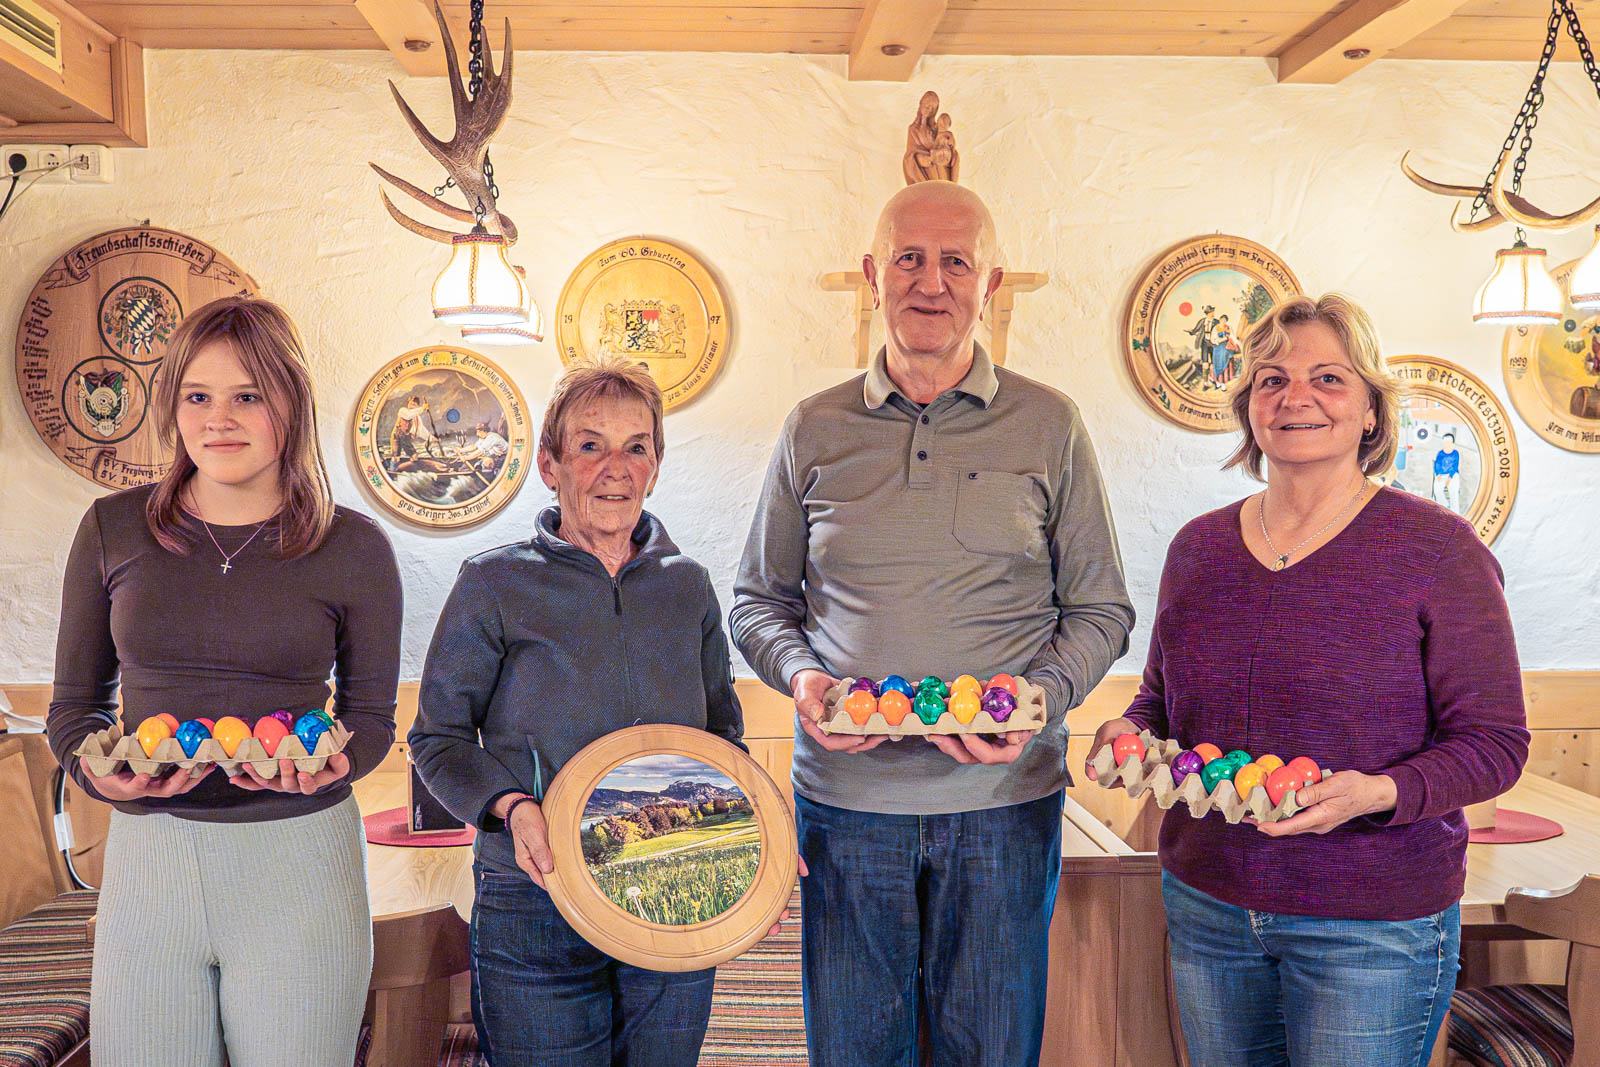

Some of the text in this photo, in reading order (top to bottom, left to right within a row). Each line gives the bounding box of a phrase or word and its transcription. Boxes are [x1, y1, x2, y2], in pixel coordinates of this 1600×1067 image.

[598, 254, 617, 267] Zum
[640, 246, 687, 270] Geburtstag
[710, 315, 721, 325] 97
[1426, 368, 1506, 446] Oktoberfestzug
[1498, 448, 1510, 479] 2018
